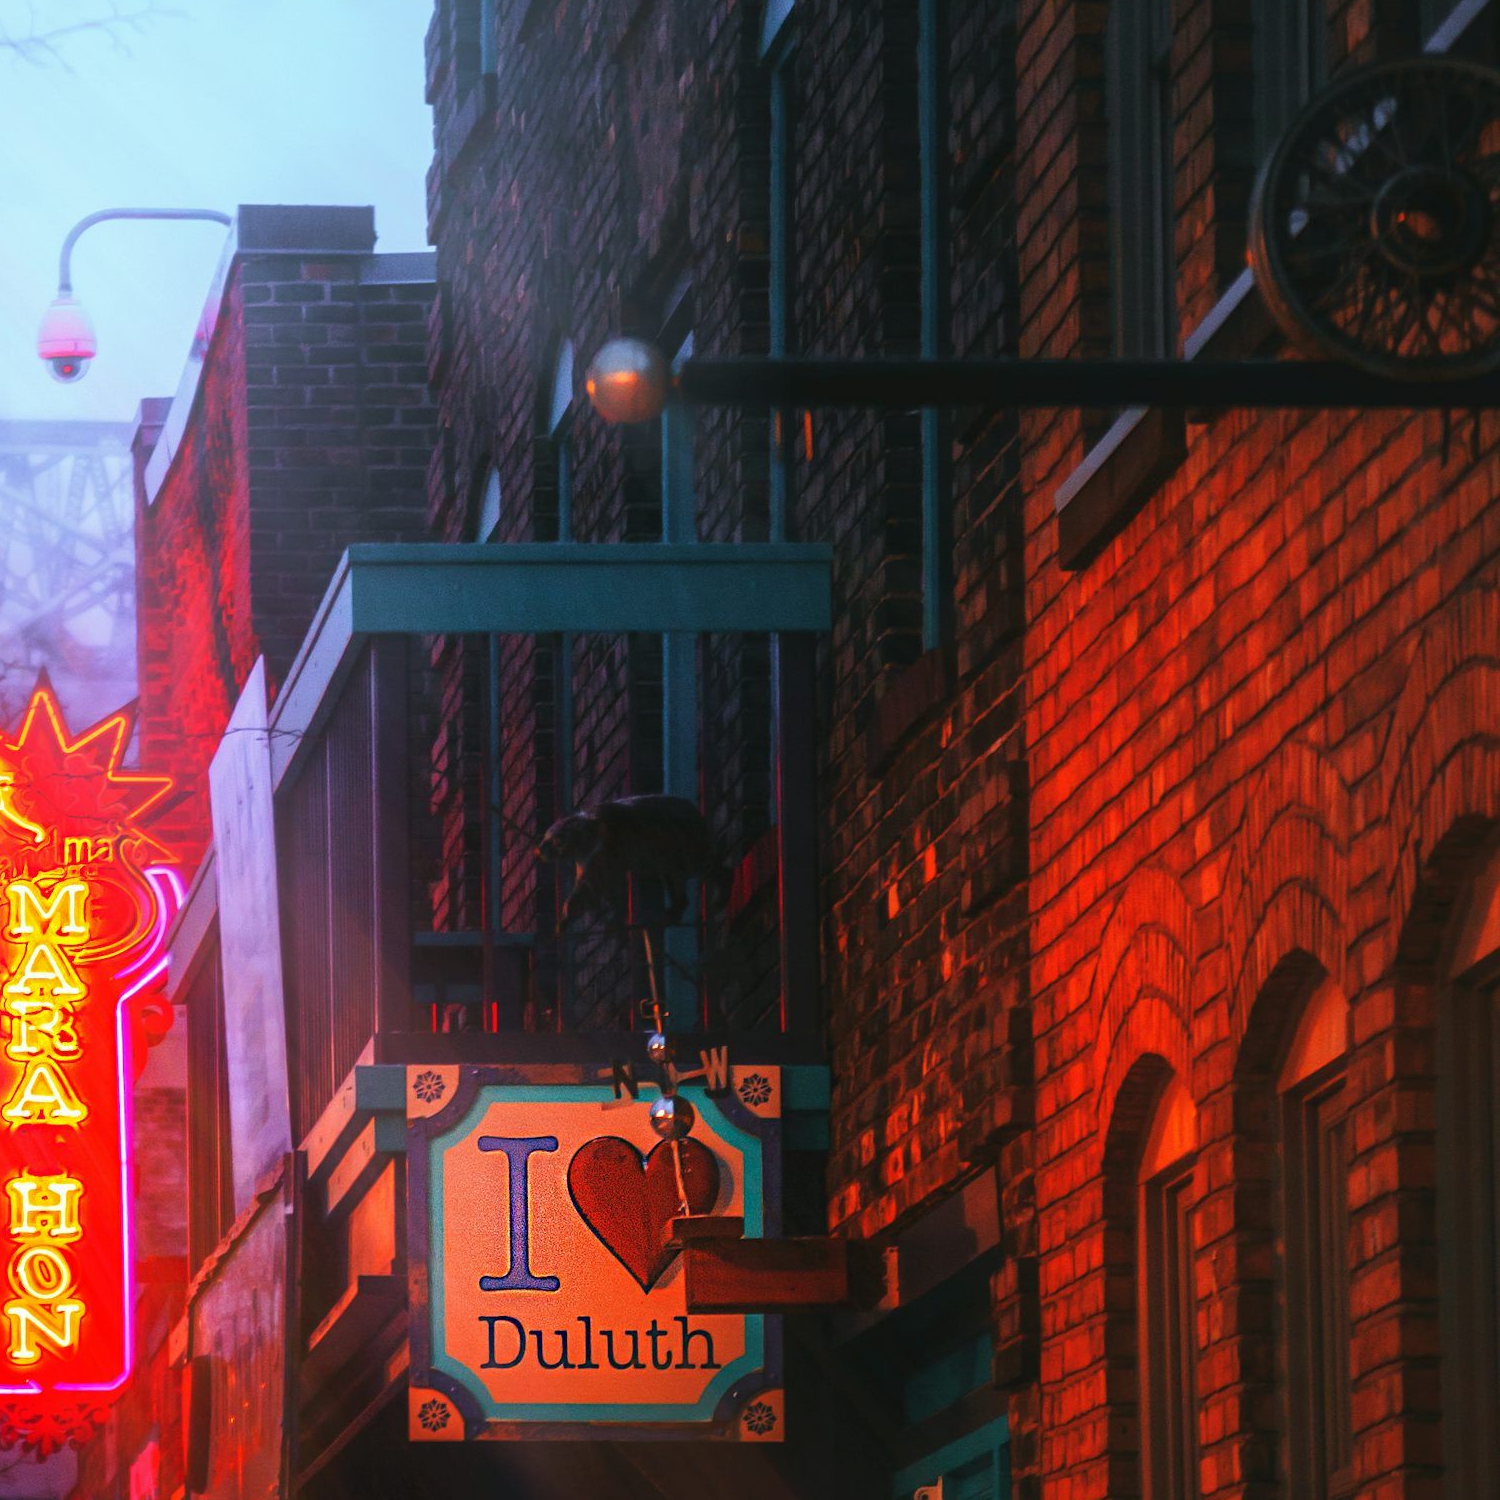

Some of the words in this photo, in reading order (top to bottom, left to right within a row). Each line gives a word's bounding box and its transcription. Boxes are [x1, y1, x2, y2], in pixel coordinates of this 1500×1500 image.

[2, 878, 90, 1364] MARAHON
[477, 1135, 560, 1293] I
[477, 1315, 722, 1371] Duluth
